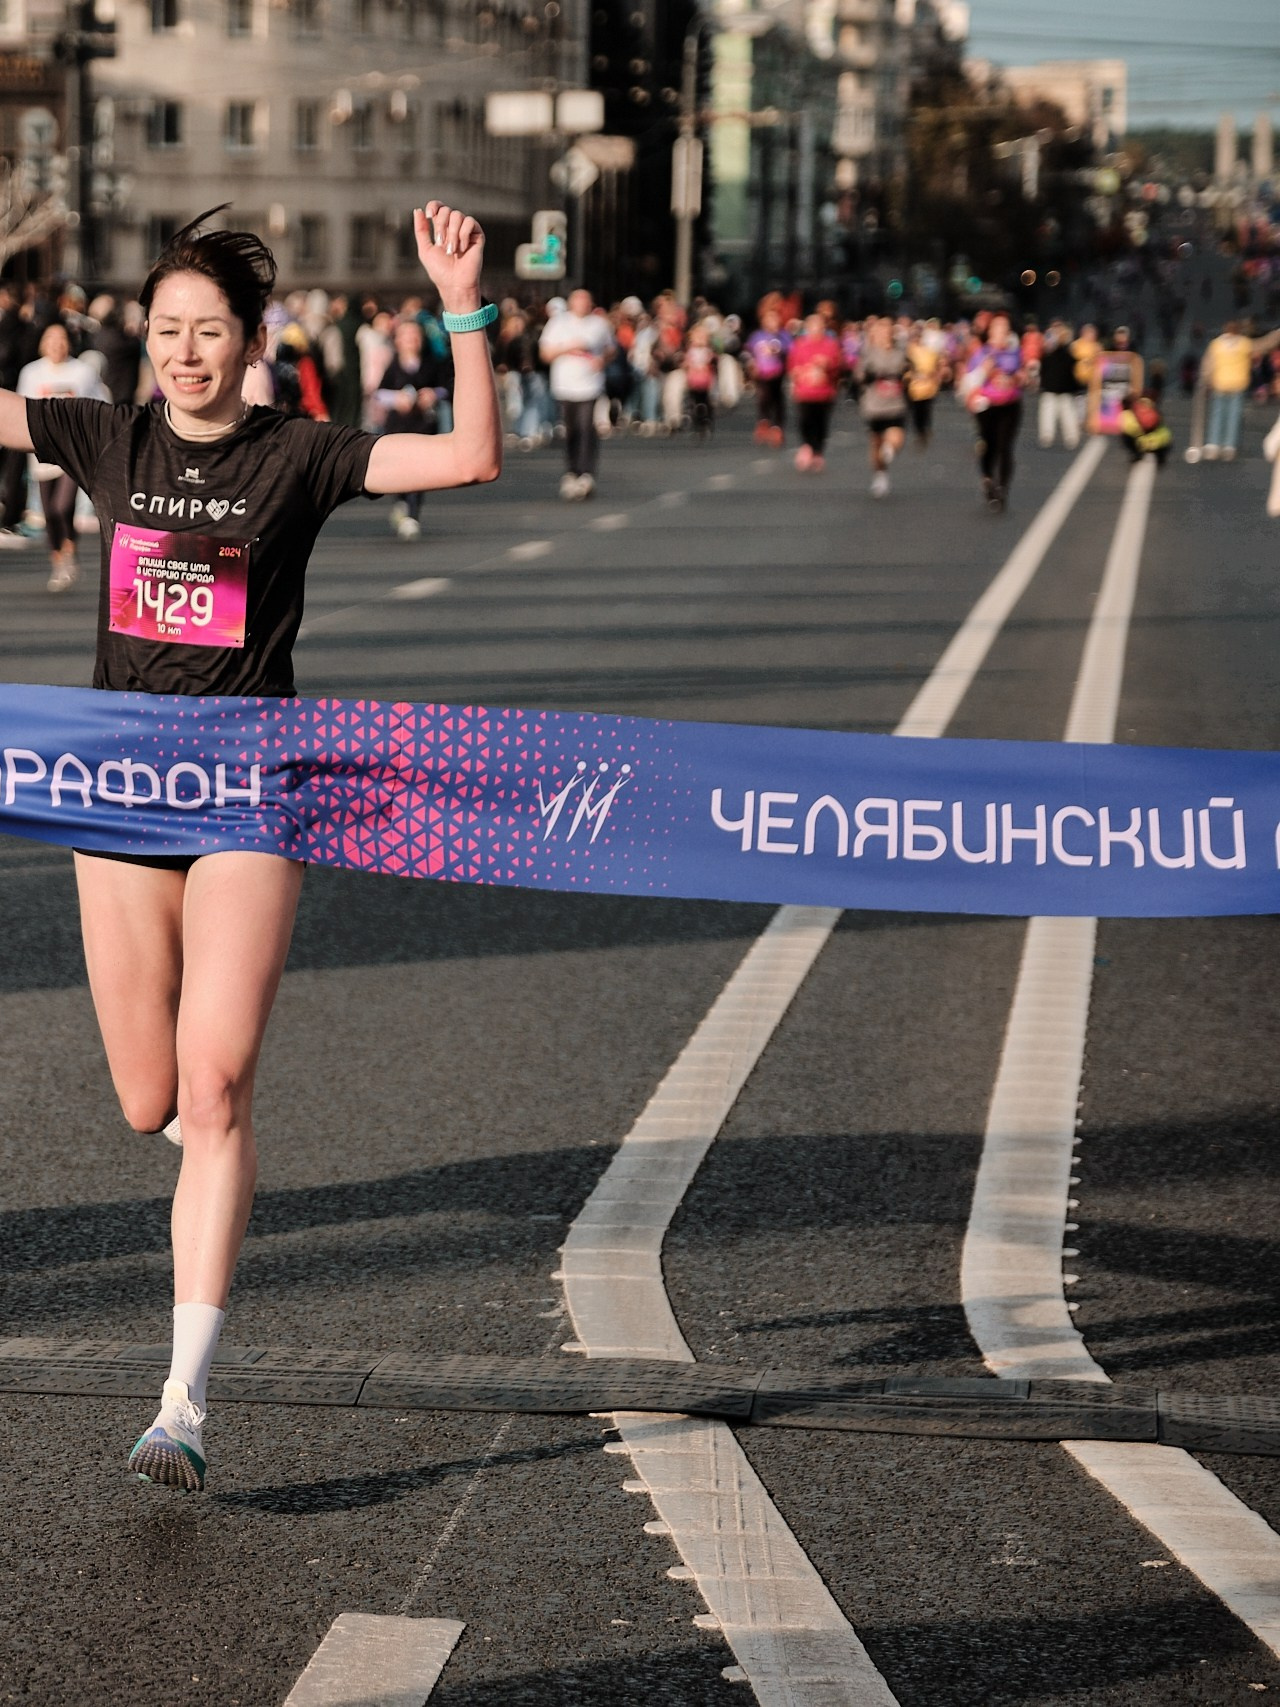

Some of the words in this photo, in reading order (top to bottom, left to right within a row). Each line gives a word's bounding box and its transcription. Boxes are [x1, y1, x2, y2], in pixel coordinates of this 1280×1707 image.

[219, 546, 242, 558] 2024
[138, 556, 166, 568] ВПИШИ
[167, 560, 189, 571] СВОЕ
[190, 563, 211, 573] ИМЯ
[136, 566, 142, 575] В
[142, 567, 180, 580] ИСТОРИЮ
[181, 572, 215, 584] ГОРОДА
[133, 578, 214, 627] 1429
[157, 623, 166, 633] 10
[711, 788, 1246, 870] ЧЕЛЯБИНСКИЙ
